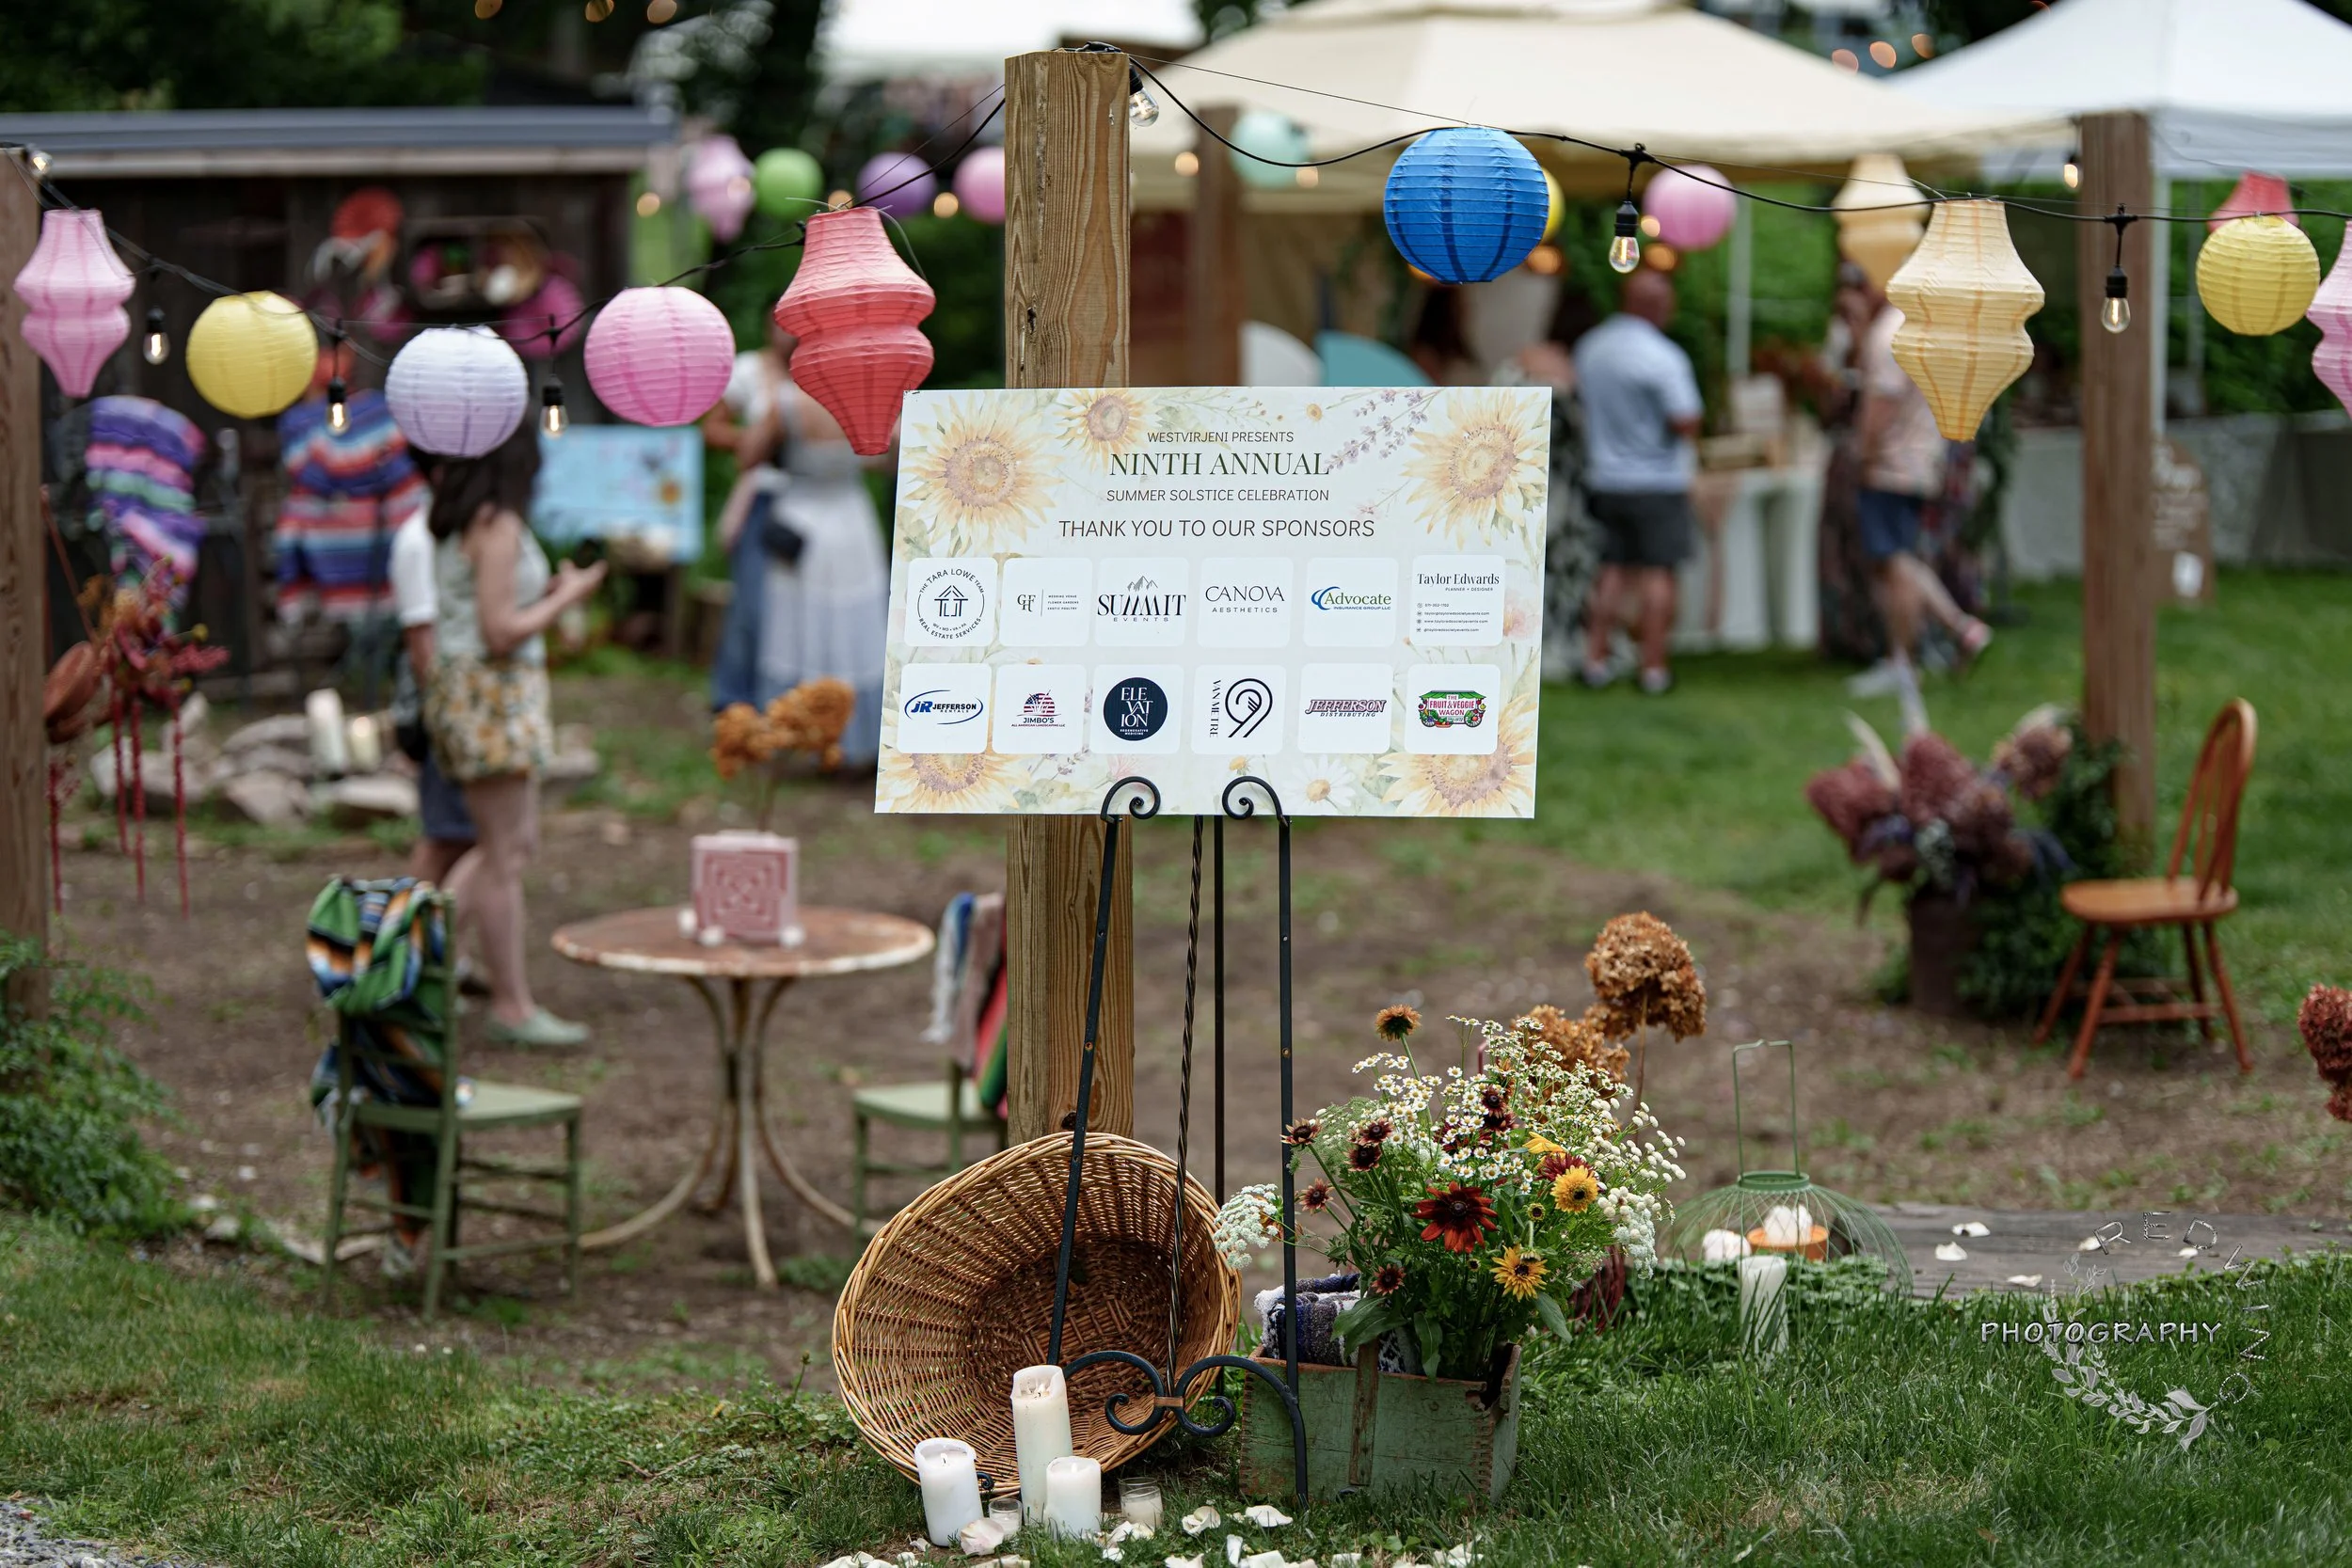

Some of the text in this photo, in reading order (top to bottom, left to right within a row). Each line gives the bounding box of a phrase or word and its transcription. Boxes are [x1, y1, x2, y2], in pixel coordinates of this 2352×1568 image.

[1147, 431, 1294, 443] WESTVIRJENI PRESENTS
[1109, 452, 1329, 476] NINTH ANNUAL
[1106, 489, 1329, 501] SUMMER SOLSTICE CELEBRATION
[1058, 519, 1375, 537] THANK YOU TO OUR SPONSORS
[919, 568, 984, 594] THE TARA LOWE TEAM
[1417, 573, 1500, 587] Taylor Edwards
[1205, 585, 1285, 602] CANOVA
[1324, 592, 1391, 605] Advocate
[1098, 594, 1186, 616] SUMMIT
[918, 617, 981, 640] REAL ESTATE SERVICES
[911, 701, 933, 713] JR
[1305, 699, 1387, 714] JEFFERSON
[1430, 700, 1447, 708] FRUIT
[1454, 700, 1474, 708] VEGGIE
